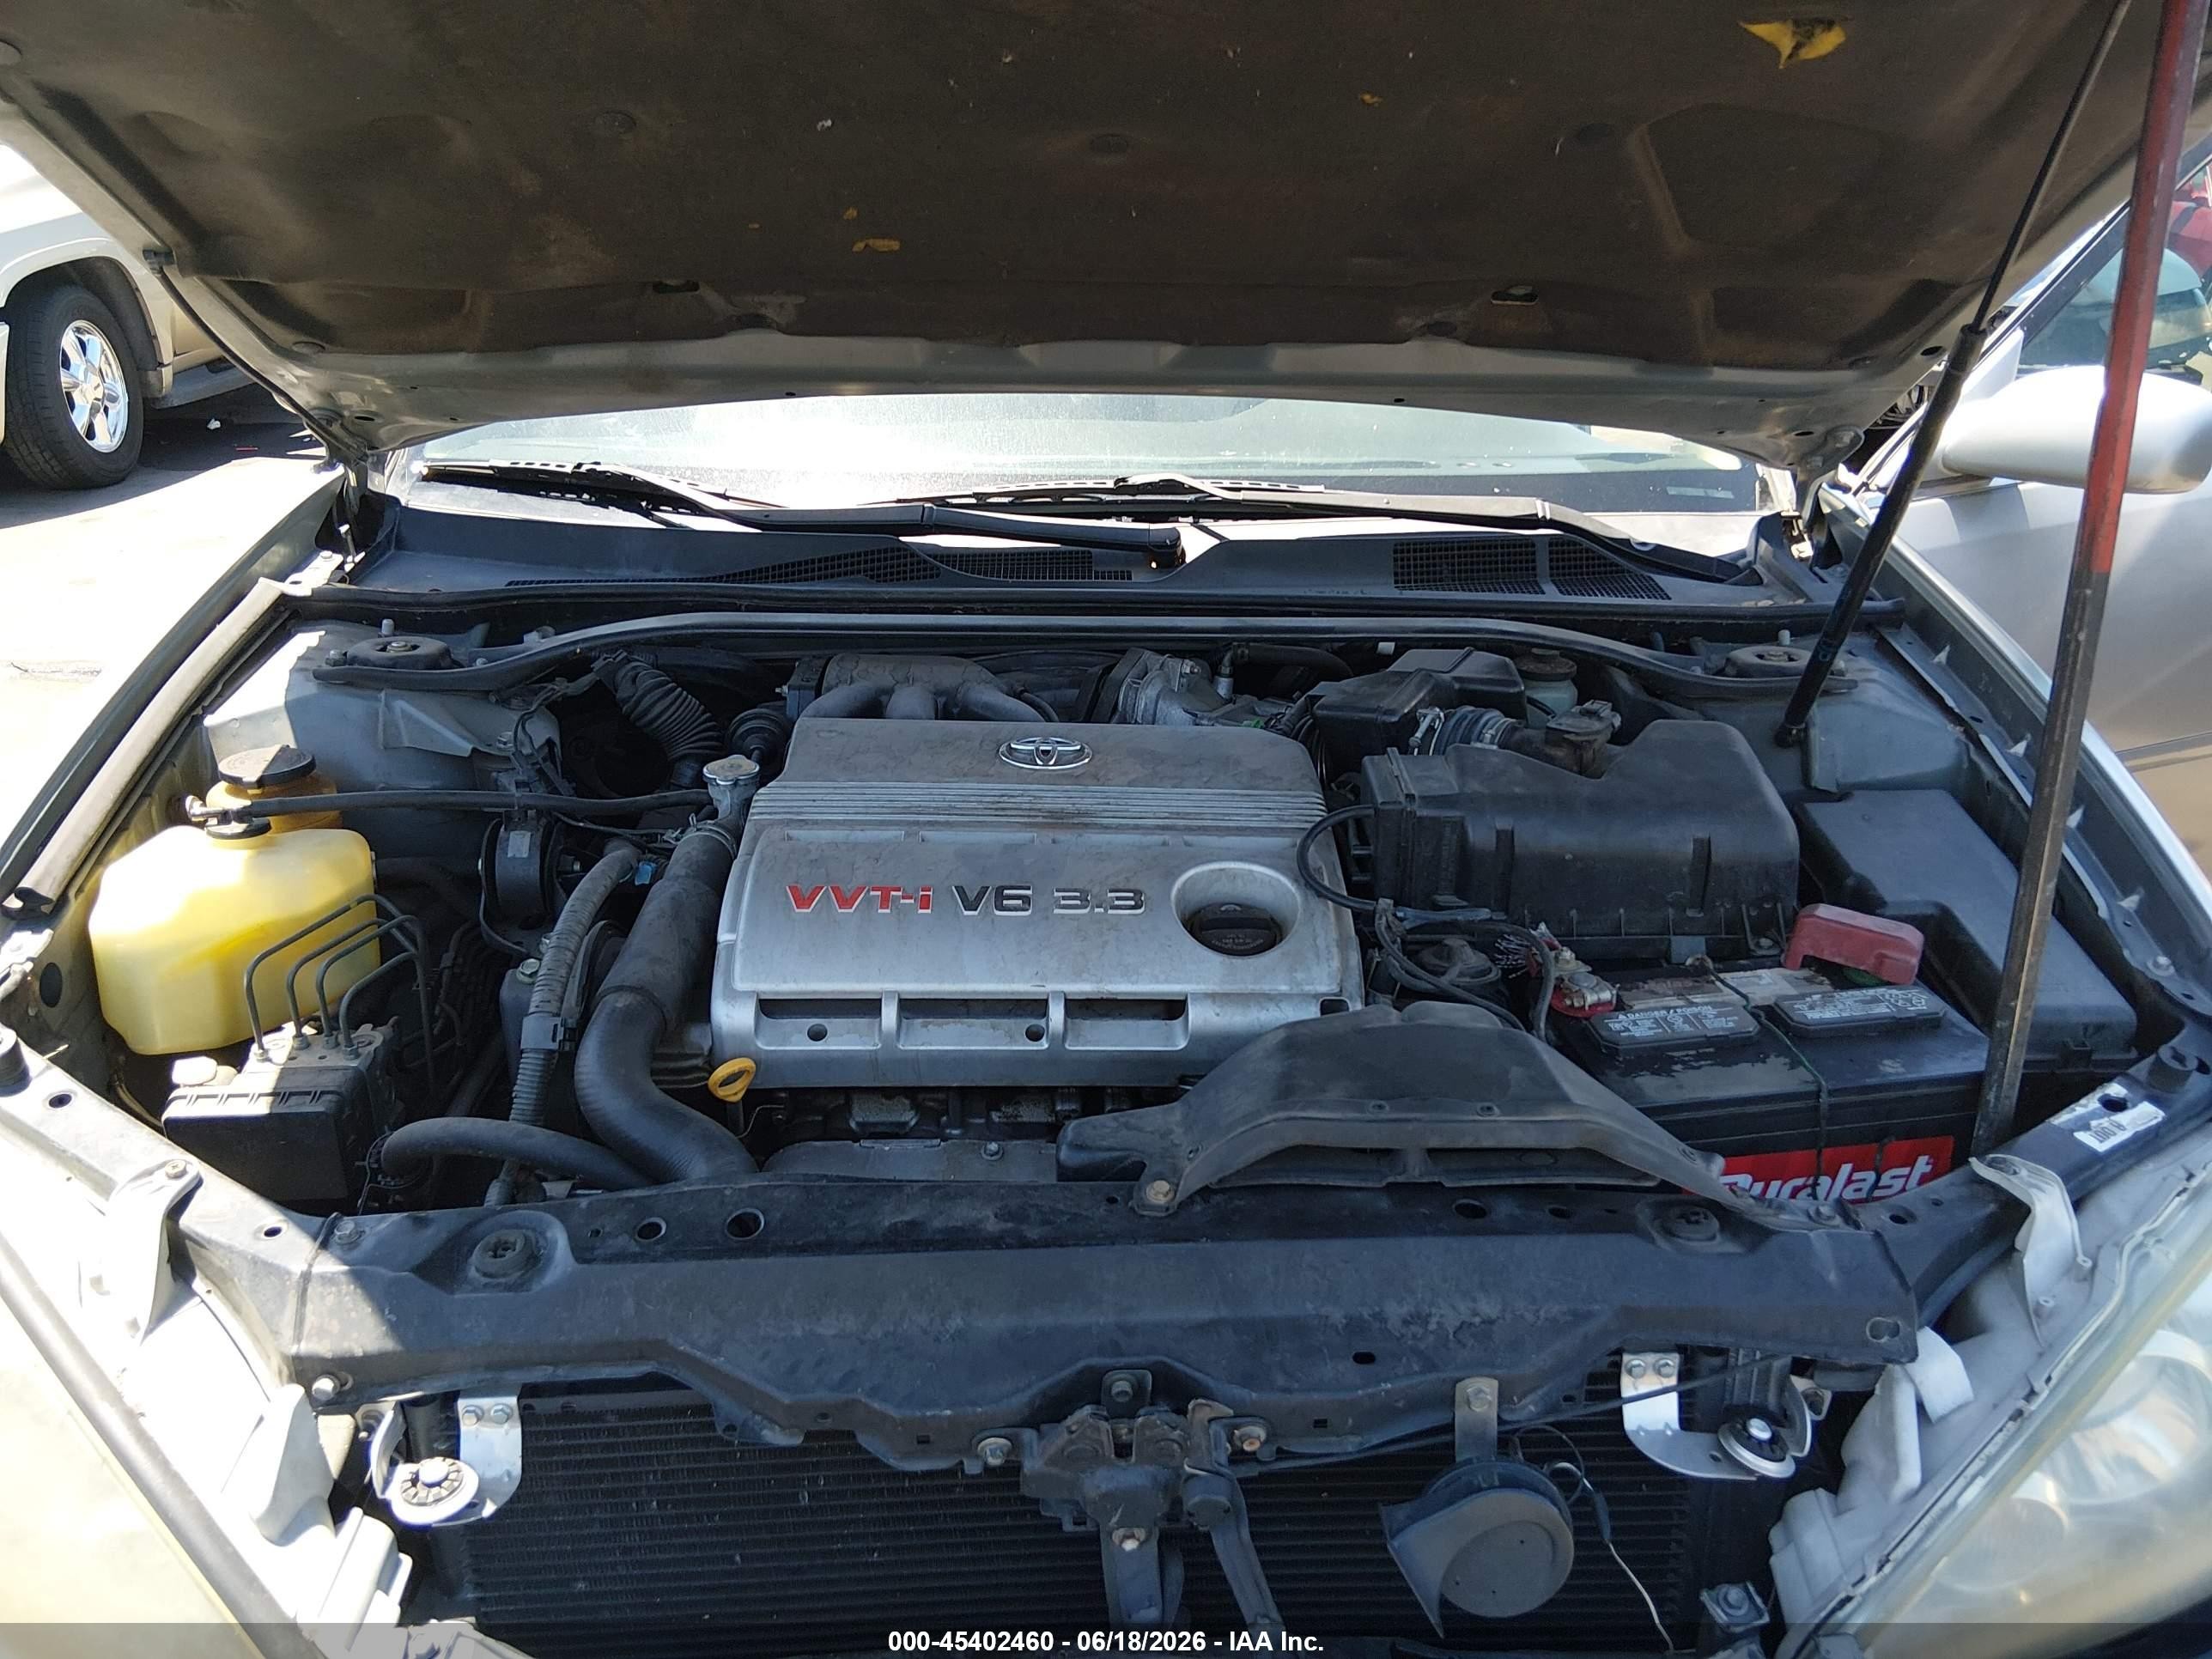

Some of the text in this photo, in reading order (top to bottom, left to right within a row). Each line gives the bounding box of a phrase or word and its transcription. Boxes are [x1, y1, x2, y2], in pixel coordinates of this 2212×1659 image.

[786, 885, 1146, 916] VVT-i V6 3.3
